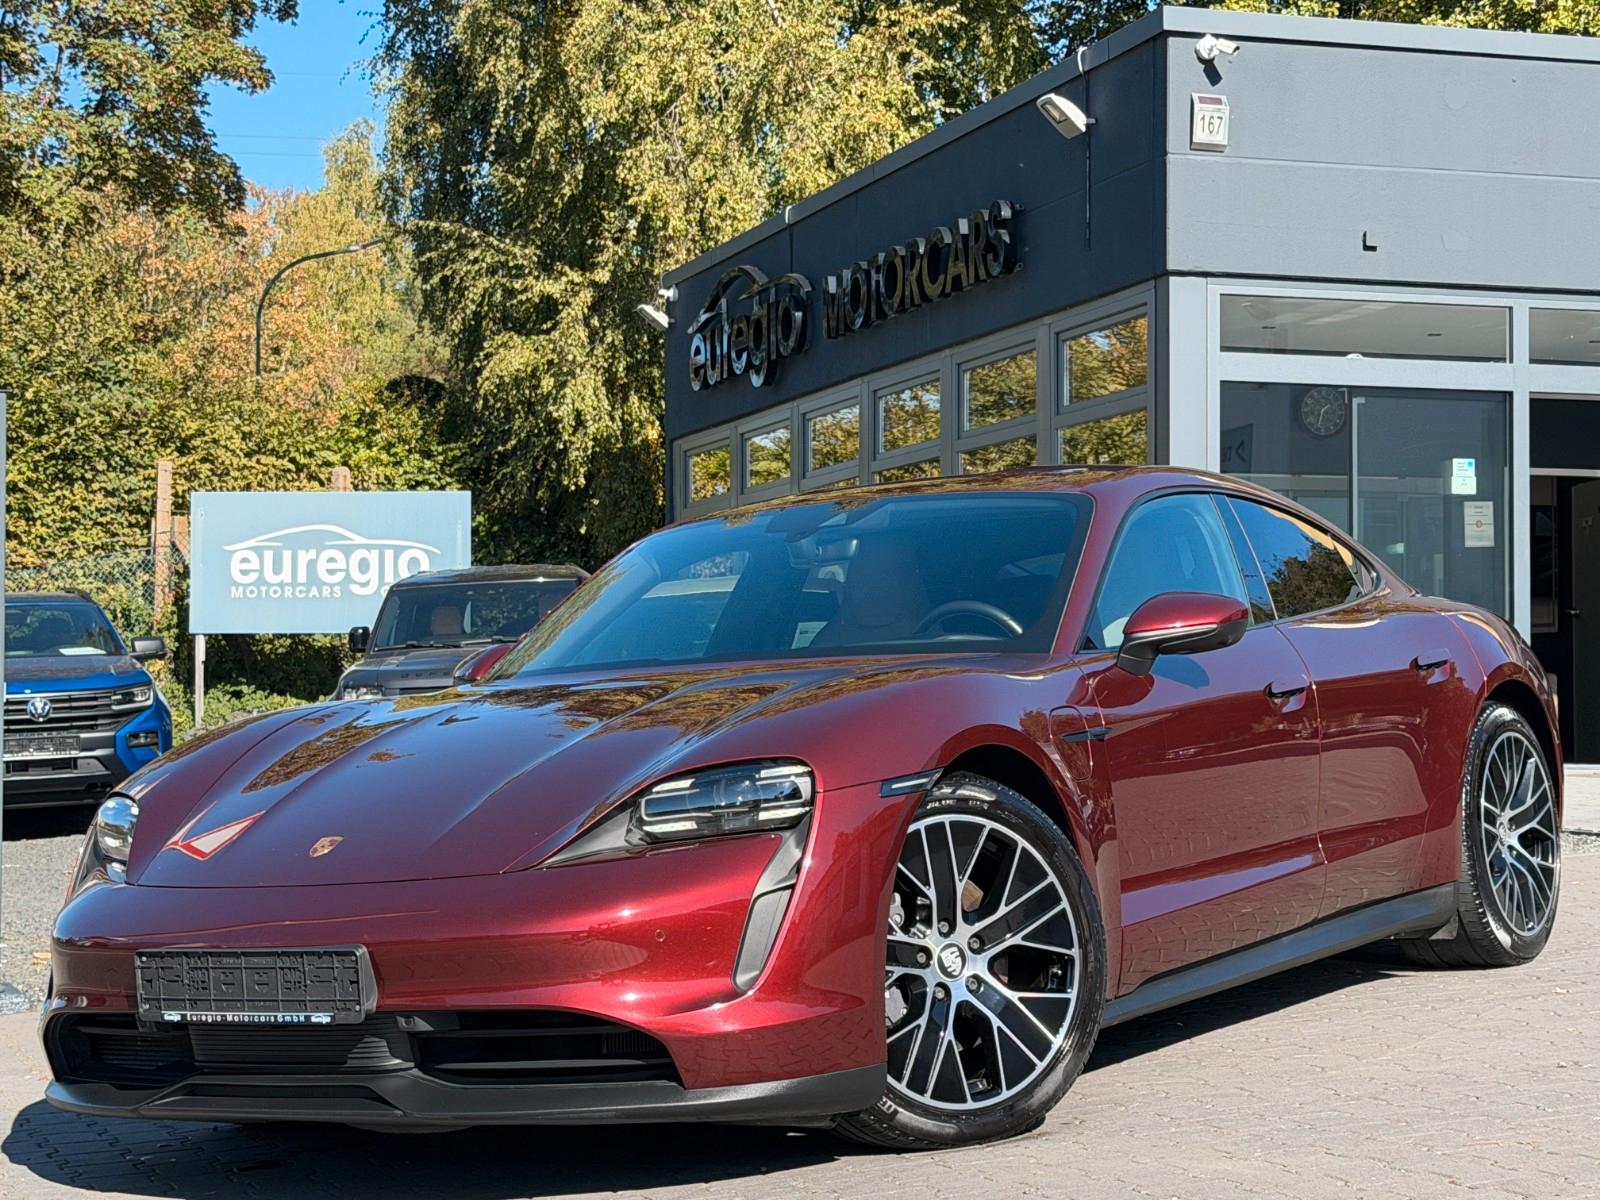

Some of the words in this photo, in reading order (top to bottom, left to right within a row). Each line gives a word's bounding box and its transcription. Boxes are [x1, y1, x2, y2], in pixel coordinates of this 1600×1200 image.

[1200, 114, 1223, 135] 167
[822, 200, 1012, 339] MOTORCARS
[230, 549, 430, 595] euregio
[231, 586, 341, 598] MOTORCARS
[277, 1014, 305, 1022] GmbH
